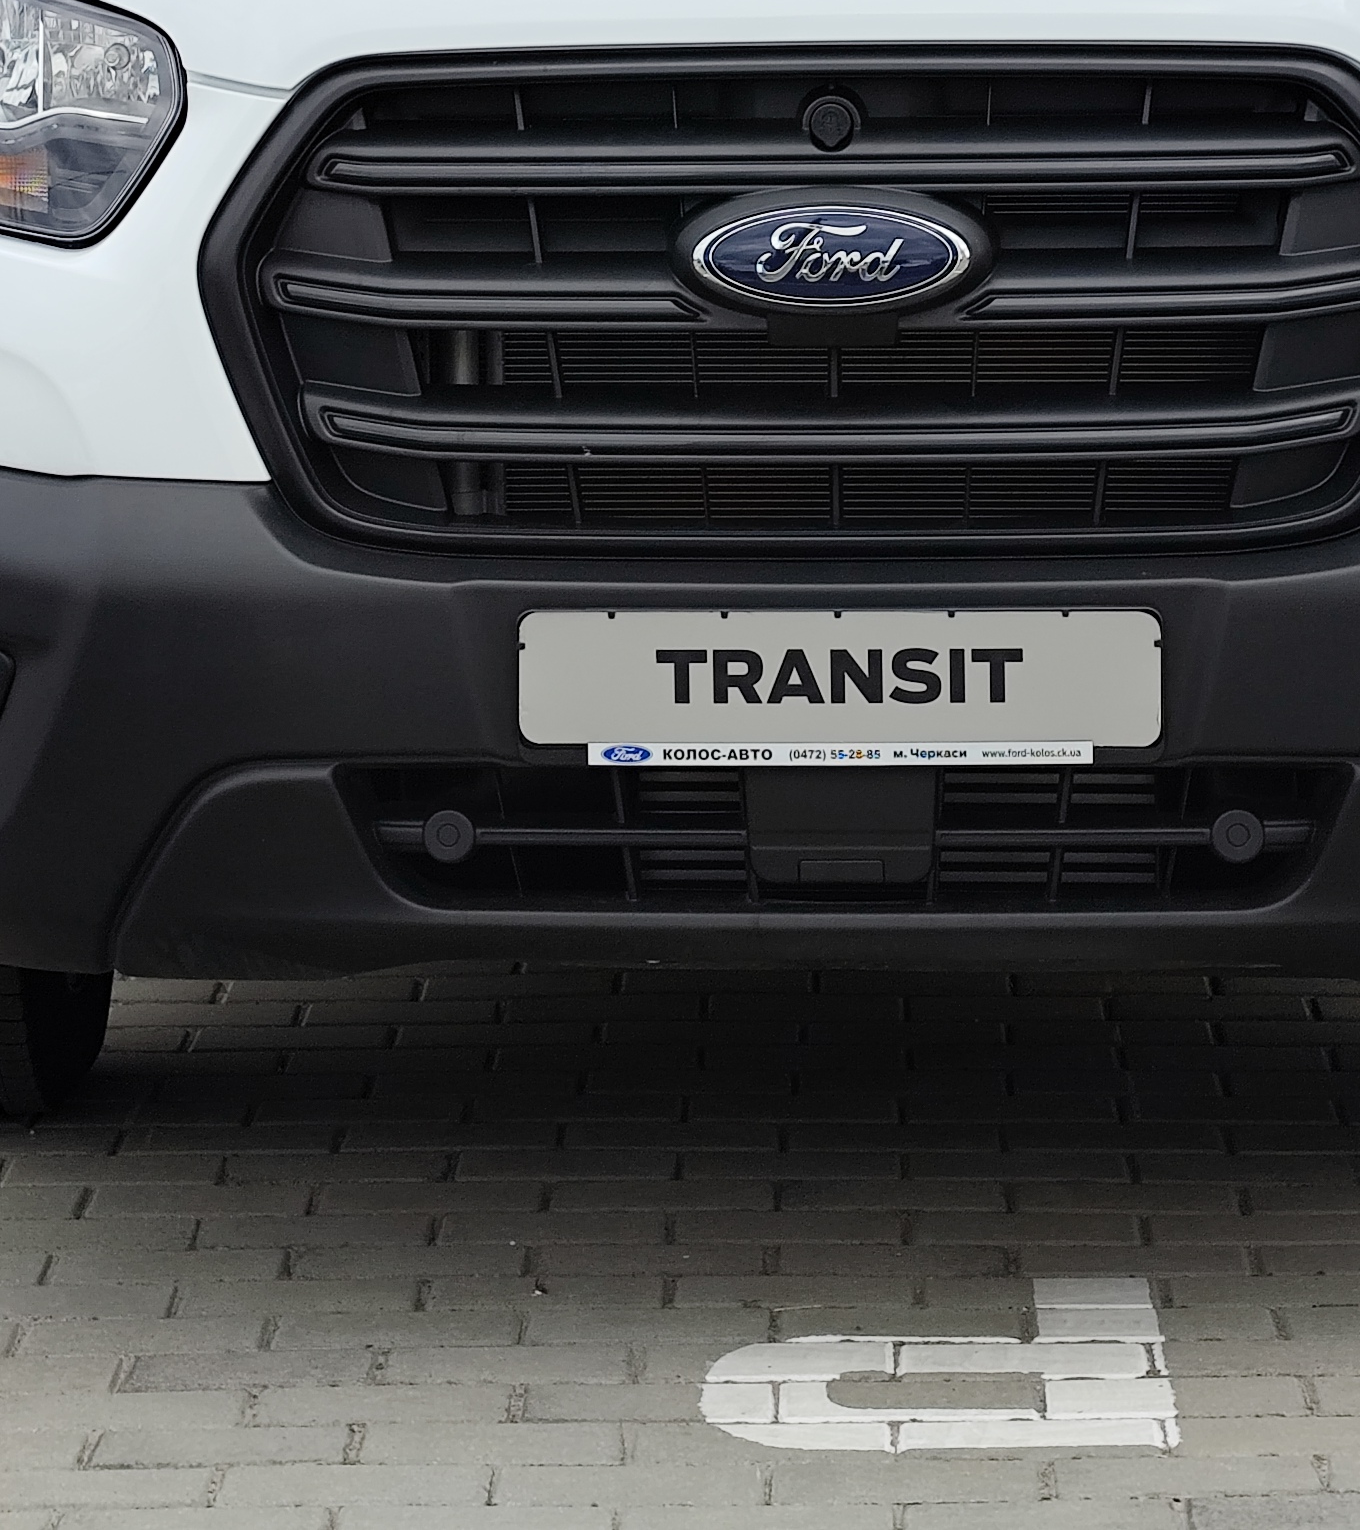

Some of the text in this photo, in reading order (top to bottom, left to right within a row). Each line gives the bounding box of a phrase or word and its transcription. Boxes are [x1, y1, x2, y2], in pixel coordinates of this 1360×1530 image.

[756, 222, 905, 283] Ford
[655, 647, 1024, 705] TRANSIT
[609, 746, 645, 762] Ford
[662, 747, 1082, 762] КОЛОС-АВТО (0472) 55-28-85 м. Черкаси www.ford-kolos.ck.ua
